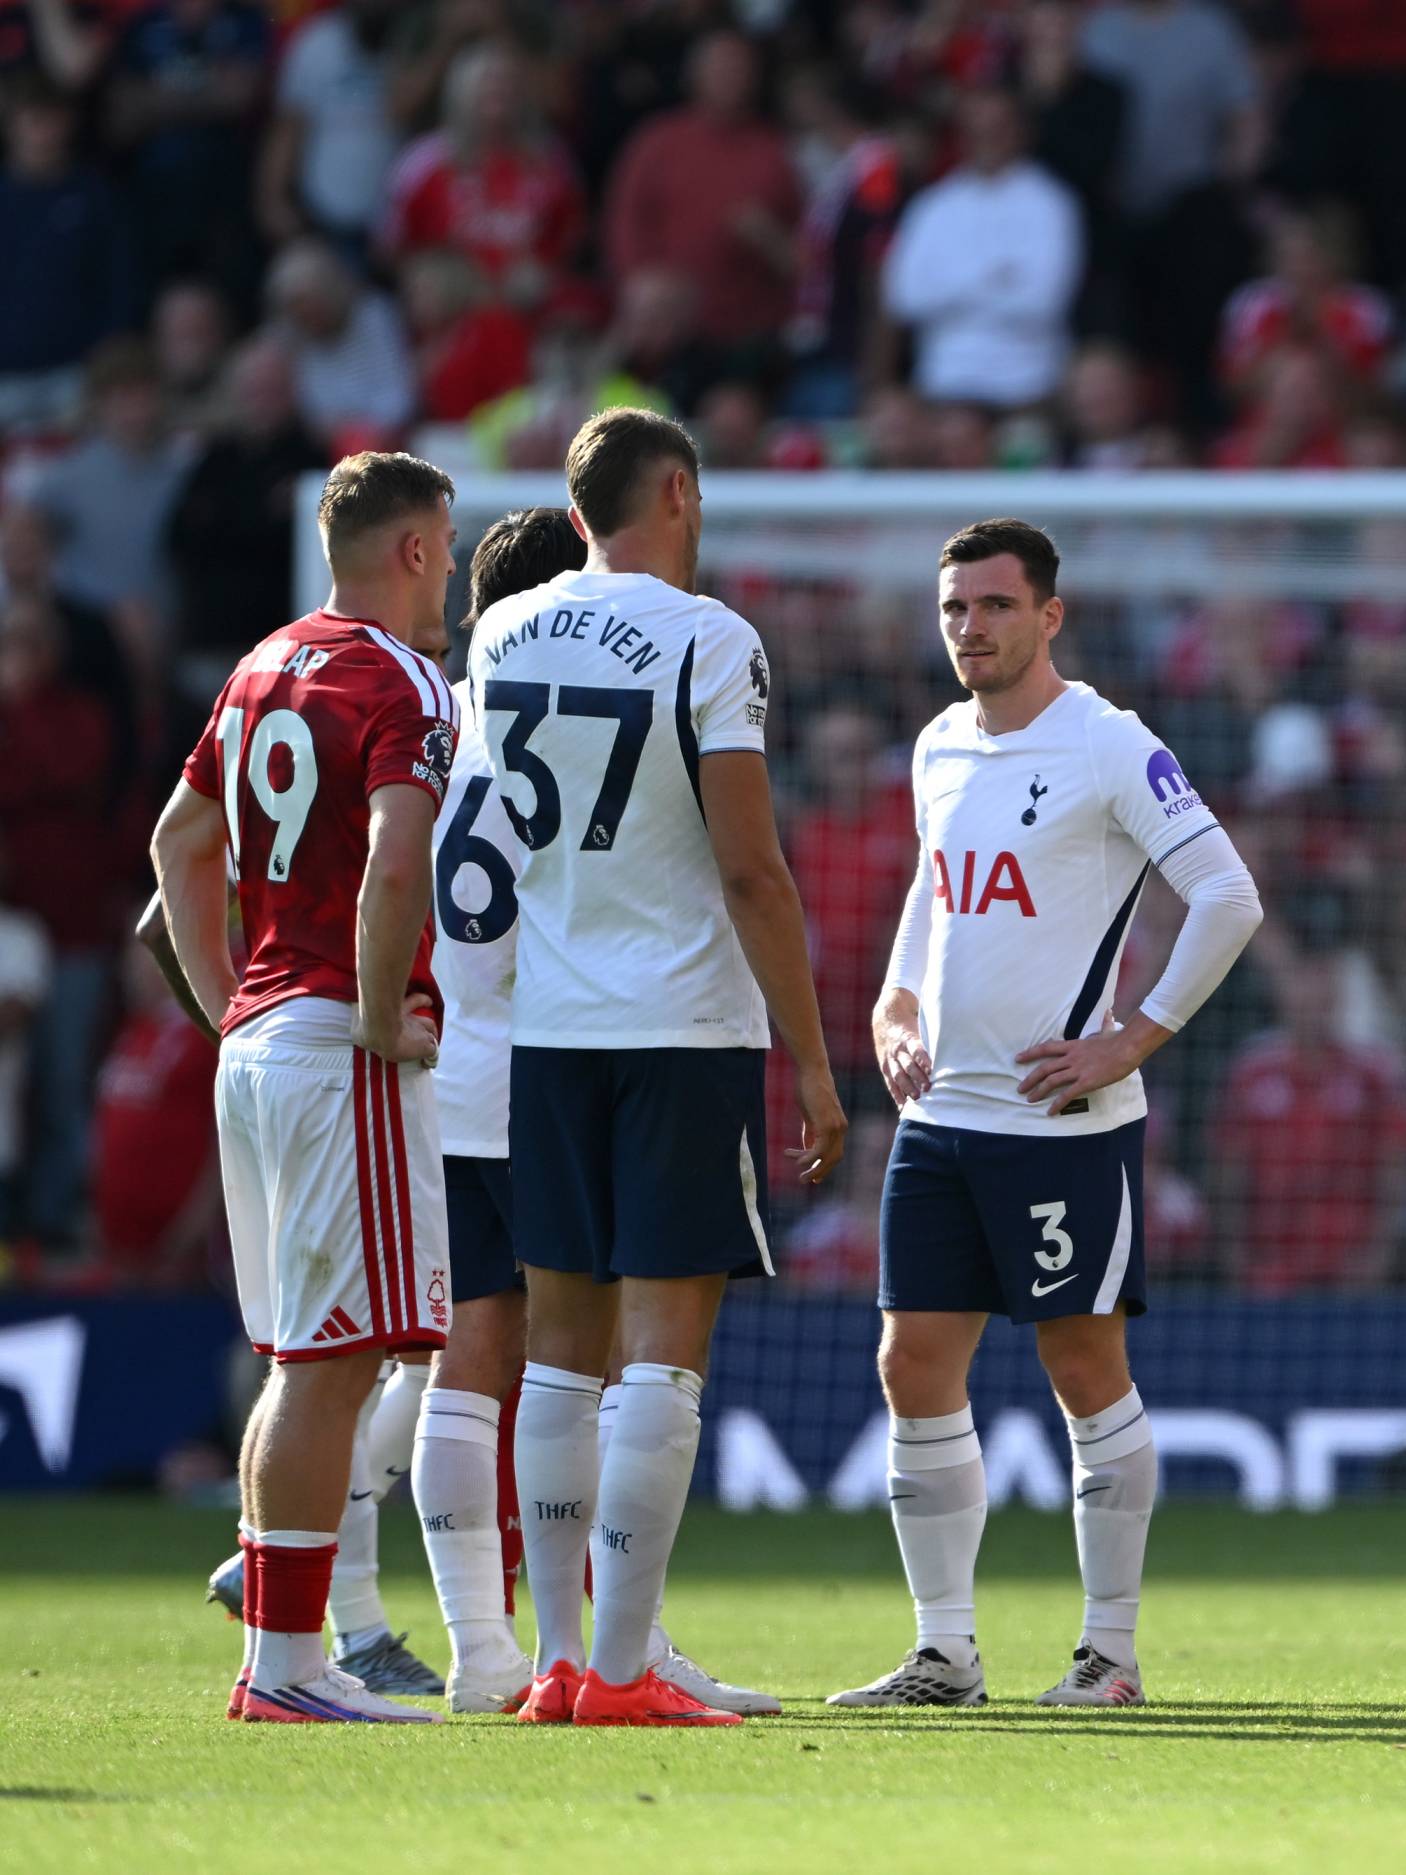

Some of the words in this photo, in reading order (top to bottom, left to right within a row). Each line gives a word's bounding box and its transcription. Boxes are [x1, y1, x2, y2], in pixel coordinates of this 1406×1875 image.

[484, 612, 540, 665] VAN
[549, 609, 596, 640] DE
[598, 615, 662, 675] VEN
[216, 706, 318, 883] 19
[485, 680, 655, 851] 37
[436, 775, 519, 944] 6
[933, 848, 1037, 918] AIA
[1030, 1201, 1074, 1271] 3
[423, 1512, 456, 1534] THFC
[534, 1499, 583, 1521] THFC
[600, 1522, 633, 1555] THFC
